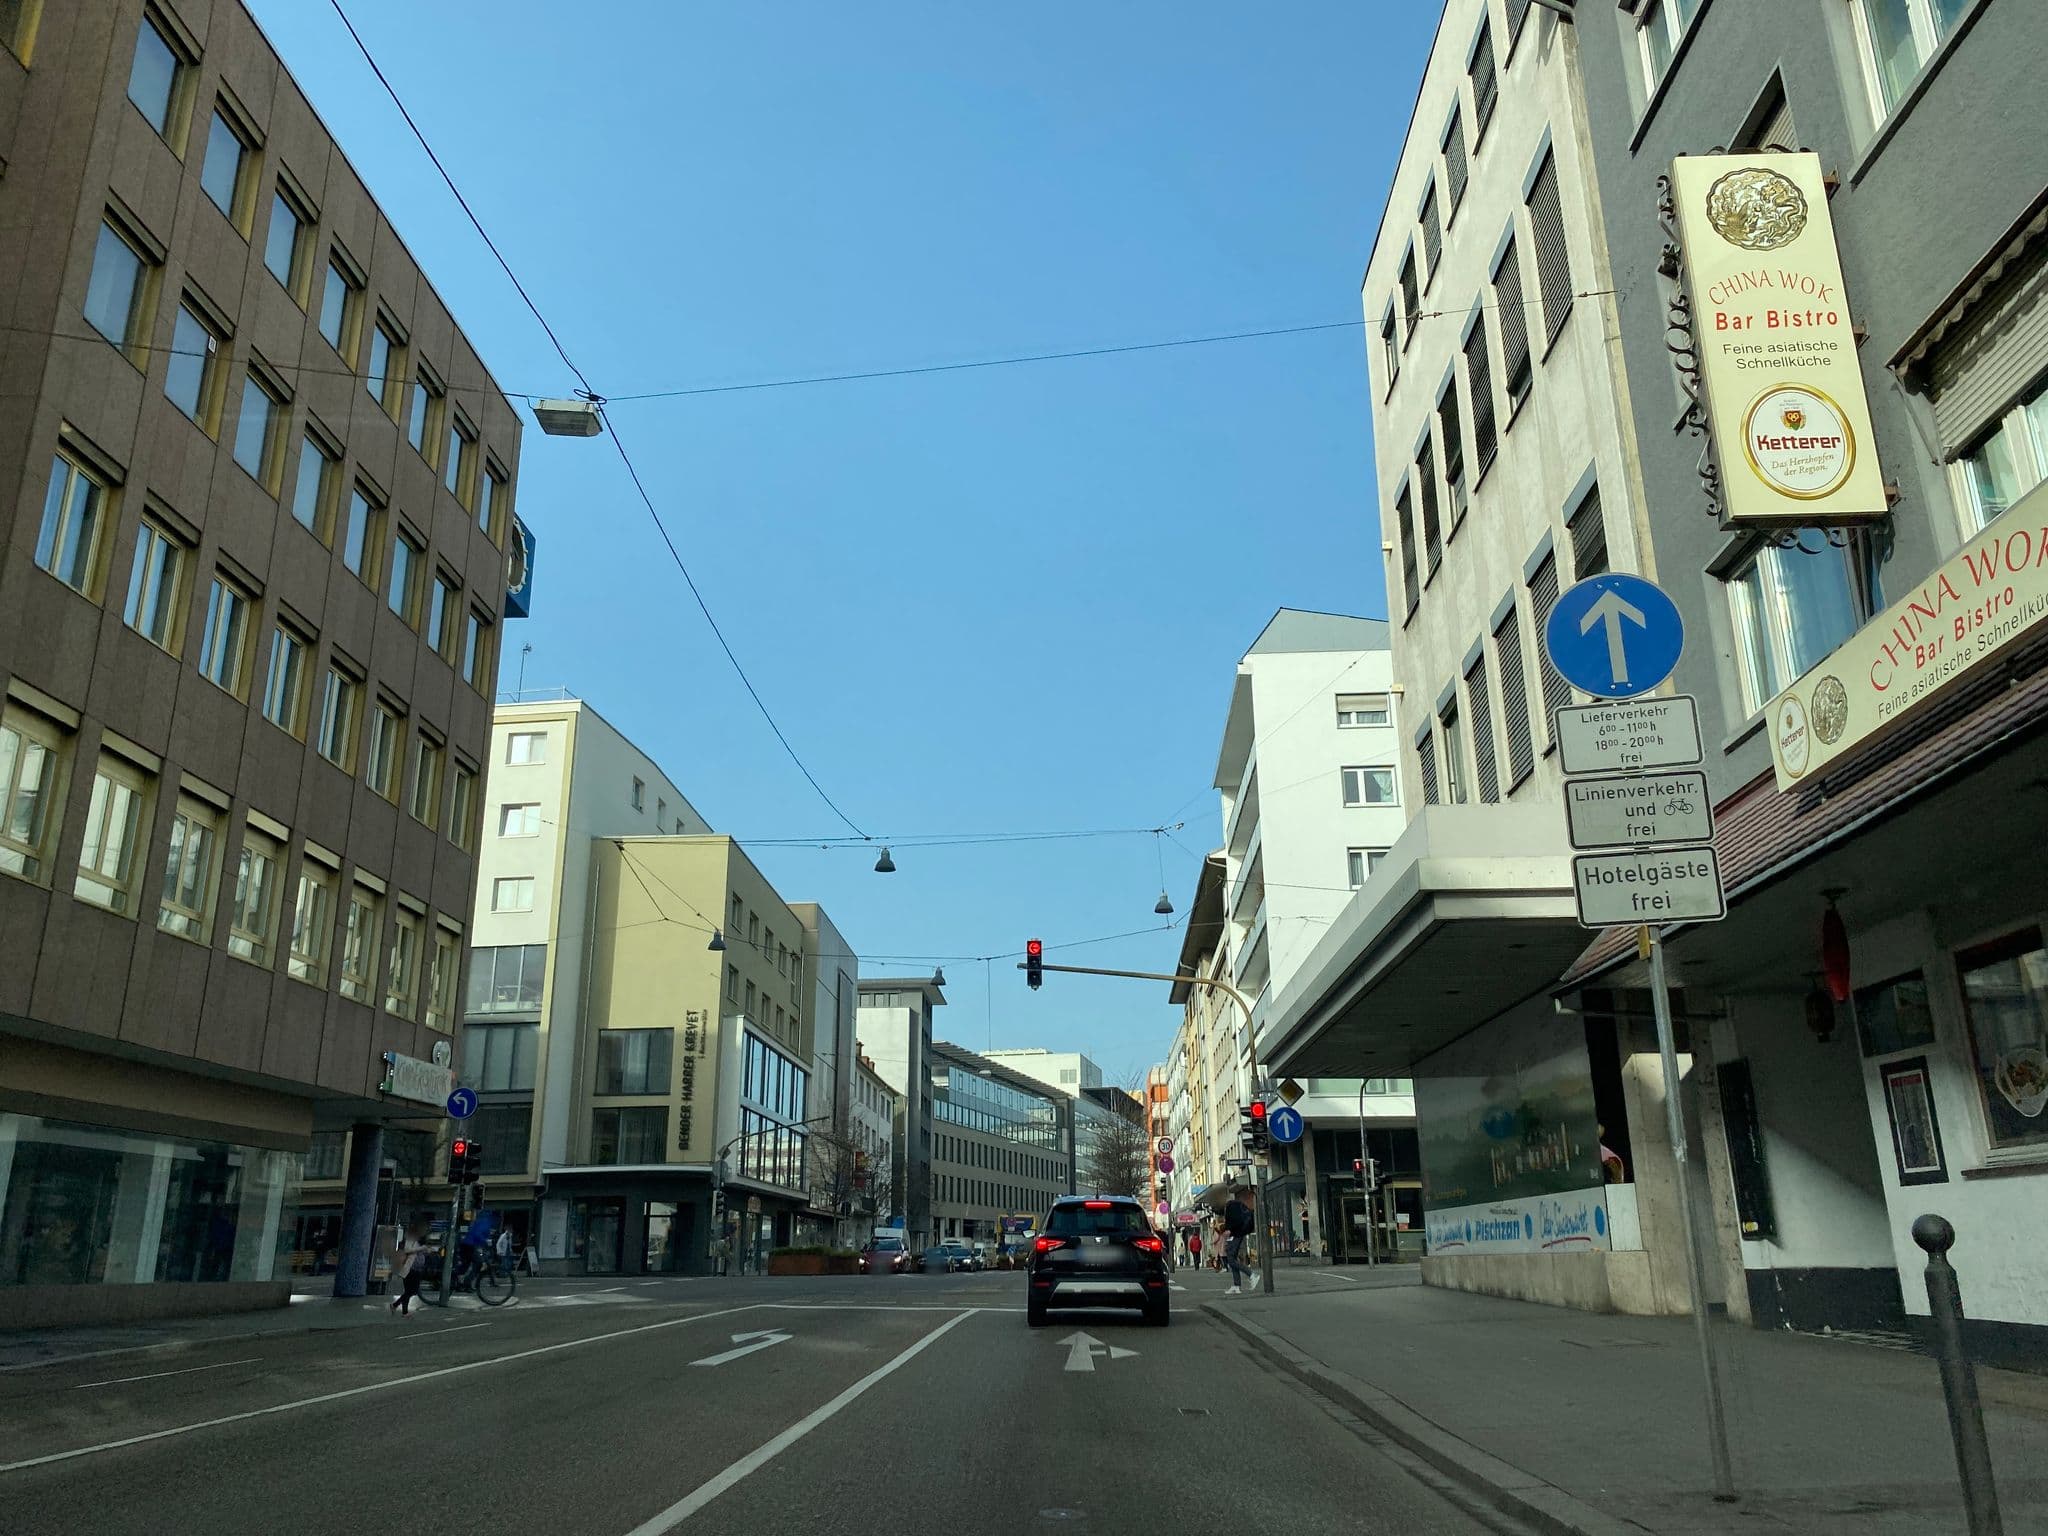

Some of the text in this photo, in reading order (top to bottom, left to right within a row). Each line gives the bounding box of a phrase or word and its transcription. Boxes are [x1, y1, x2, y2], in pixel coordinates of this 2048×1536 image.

[1709, 270, 1833, 305] CHINA WOK
[1715, 310, 1838, 330] Bar Bistro
[1722, 341, 1838, 354] Feine asiatische
[1736, 356, 1831, 369] Schnellküche
[1756, 435, 1841, 450] Ketterer
[1772, 460, 1787, 469] Das
[1784, 468, 1797, 476] der
[1870, 573, 1961, 692] CHINA
[1915, 586, 2014, 669] Bar Bistro
[1877, 694, 1908, 720] Feine
[1911, 650, 1972, 698] asiatische
[1581, 706, 1669, 723] Lieferverkehr
[1620, 752, 1643, 763] frei
[1625, 803, 1656, 817] und
[1627, 823, 1656, 837] frei
[1584, 861, 1709, 886] Hotelgäste
[1632, 890, 1671, 911] frei
[685, 1010, 699, 1051] KREVET
[1161, 1141, 1170, 1151] 30
